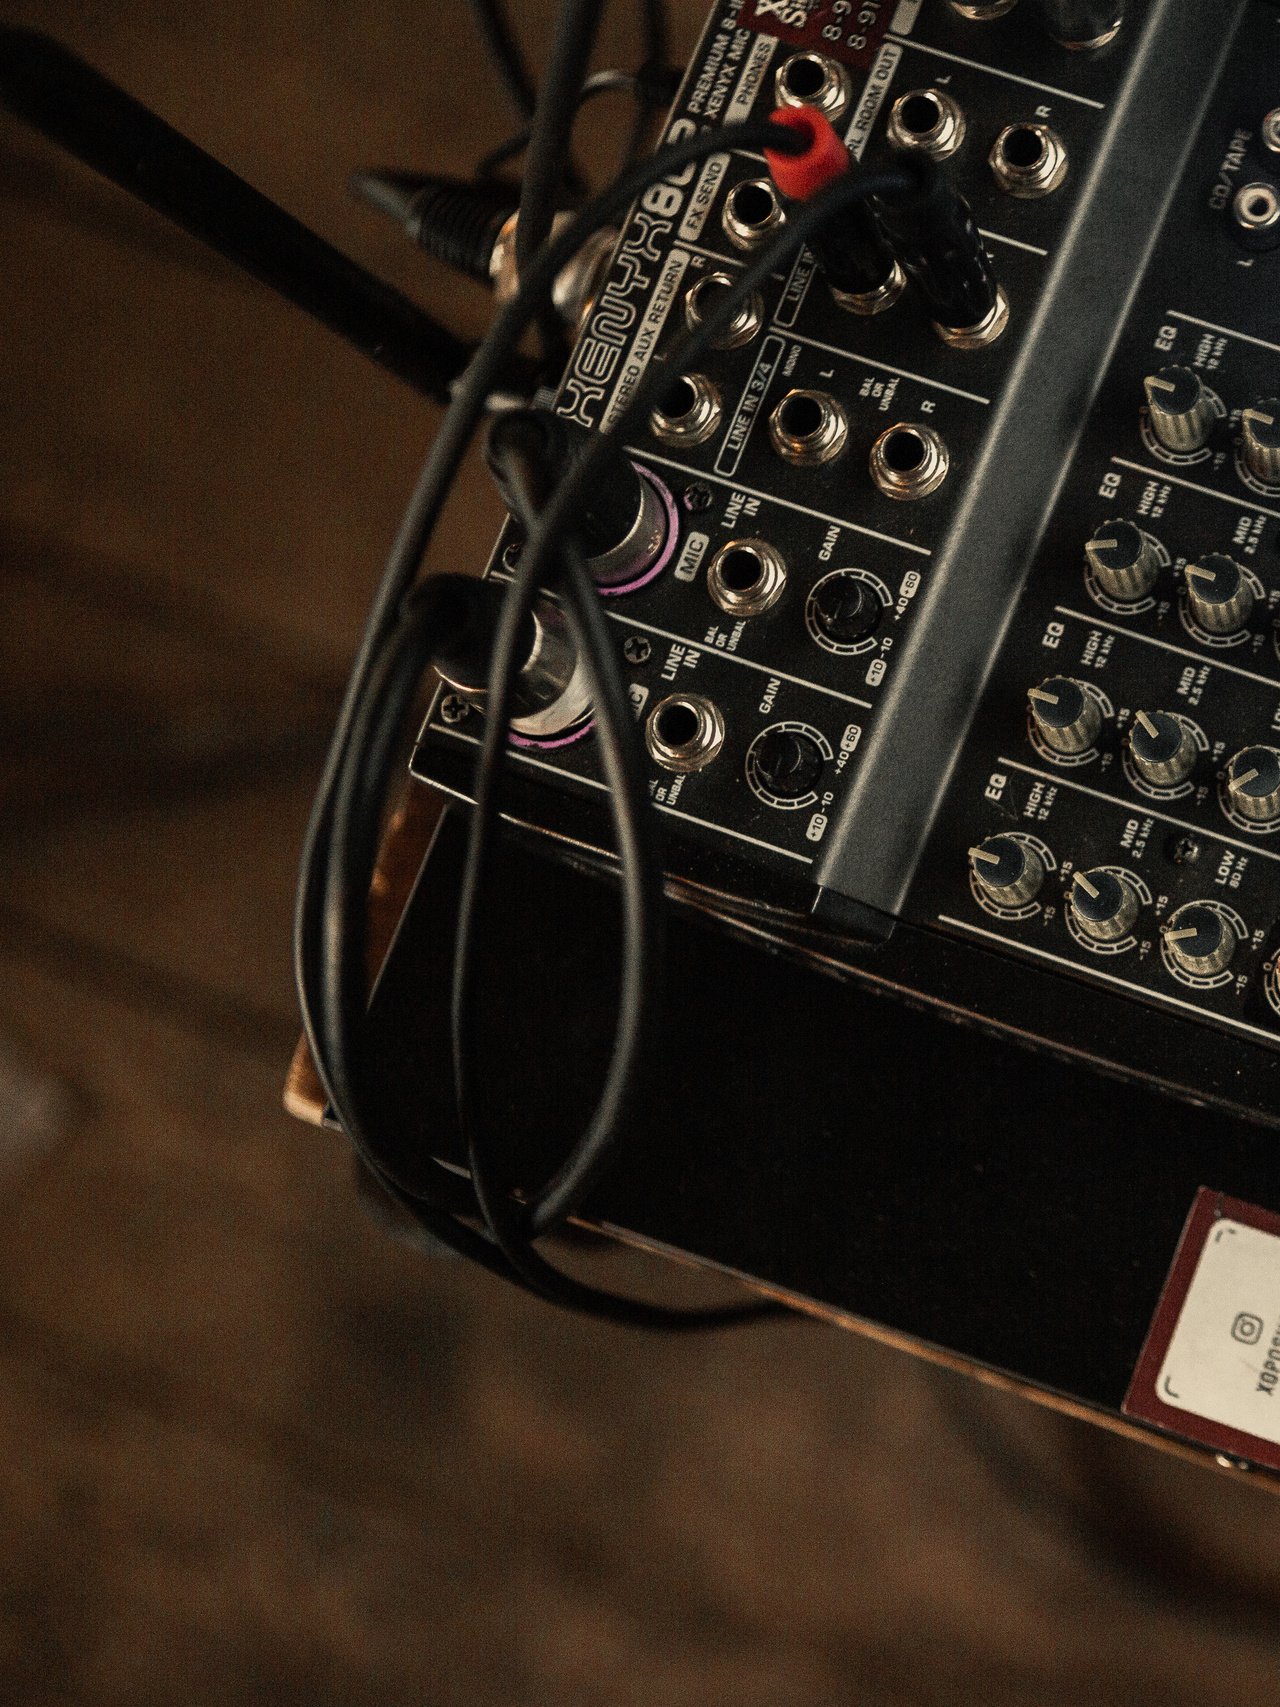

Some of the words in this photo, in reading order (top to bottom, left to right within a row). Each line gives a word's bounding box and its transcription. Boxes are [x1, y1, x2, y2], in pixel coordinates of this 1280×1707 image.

[686, 32, 731, 114] PREMIUM
[736, 40, 771, 105] PHONES
[703, 62, 737, 120] XENYX
[855, 84, 882, 130] ROOM
[875, 49, 897, 81] OUT
[1034, 103, 1052, 118] R
[1207, 127, 1252, 210] CD/TAPE
[686, 206, 704, 229] FX
[696, 160, 723, 204] SEND
[690, 254, 706, 268] R
[786, 267, 810, 301] LINE
[632, 327, 656, 361] AUX
[648, 259, 683, 323] RETURN
[1154, 323, 1178, 351] EQ
[781, 343, 803, 376] MONO
[819, 366, 834, 378] L
[750, 360, 772, 391] 3/4
[859, 374, 876, 397] BAL
[871, 381, 885, 398] OR
[742, 393, 759, 412] IN
[878, 375, 900, 411] UNBAL
[920, 399, 936, 413] R
[727, 414, 751, 450] LINE
[1097, 470, 1123, 499] EQ
[1136, 480, 1159, 515] HIGH
[720, 491, 746, 528] LINE
[743, 497, 761, 516] IN
[818, 524, 841, 561] GAIN
[1232, 515, 1253, 544] MID
[679, 538, 704, 574] MIC
[892, 596, 909, 621] +40
[902, 573, 918, 595] +60
[704, 623, 719, 643] BAL
[715, 633, 728, 647] OR
[727, 619, 746, 651] UNBAL
[1041, 619, 1065, 648] EQ
[1080, 629, 1102, 665] HIGH
[660, 643, 686, 681] LINE
[682, 649, 700, 667] IN
[868, 661, 883, 682] +10
[877, 636, 893, 659] -10
[1177, 665, 1196, 694] MID
[757, 677, 782, 714] GAIN
[832, 750, 850, 775] +40
[843, 725, 860, 748] +60
[654, 786, 667, 801] OR
[666, 772, 686, 805] UNBAL
[984, 771, 1008, 800] EQ
[1023, 781, 1046, 817] HIGH
[1043, 785, 1058, 806] kHz
[808, 815, 825, 838] +10
[818, 790, 834, 813] -10
[1037, 807, 1050, 821] 12
[1120, 818, 1140, 848] MID
[1131, 839, 1146, 858] 2.5
[1139, 816, 1154, 837] kHz
[1057, 860, 1073, 882] +15
[1215, 850, 1236, 884] LOW
[1235, 855, 1248, 870] Hz
[1040, 905, 1056, 927] -15
[1153, 894, 1169, 916] +15
[1136, 939, 1152, 961] -15
[1249, 928, 1265, 951] +15
[1233, 973, 1248, 995] -15
